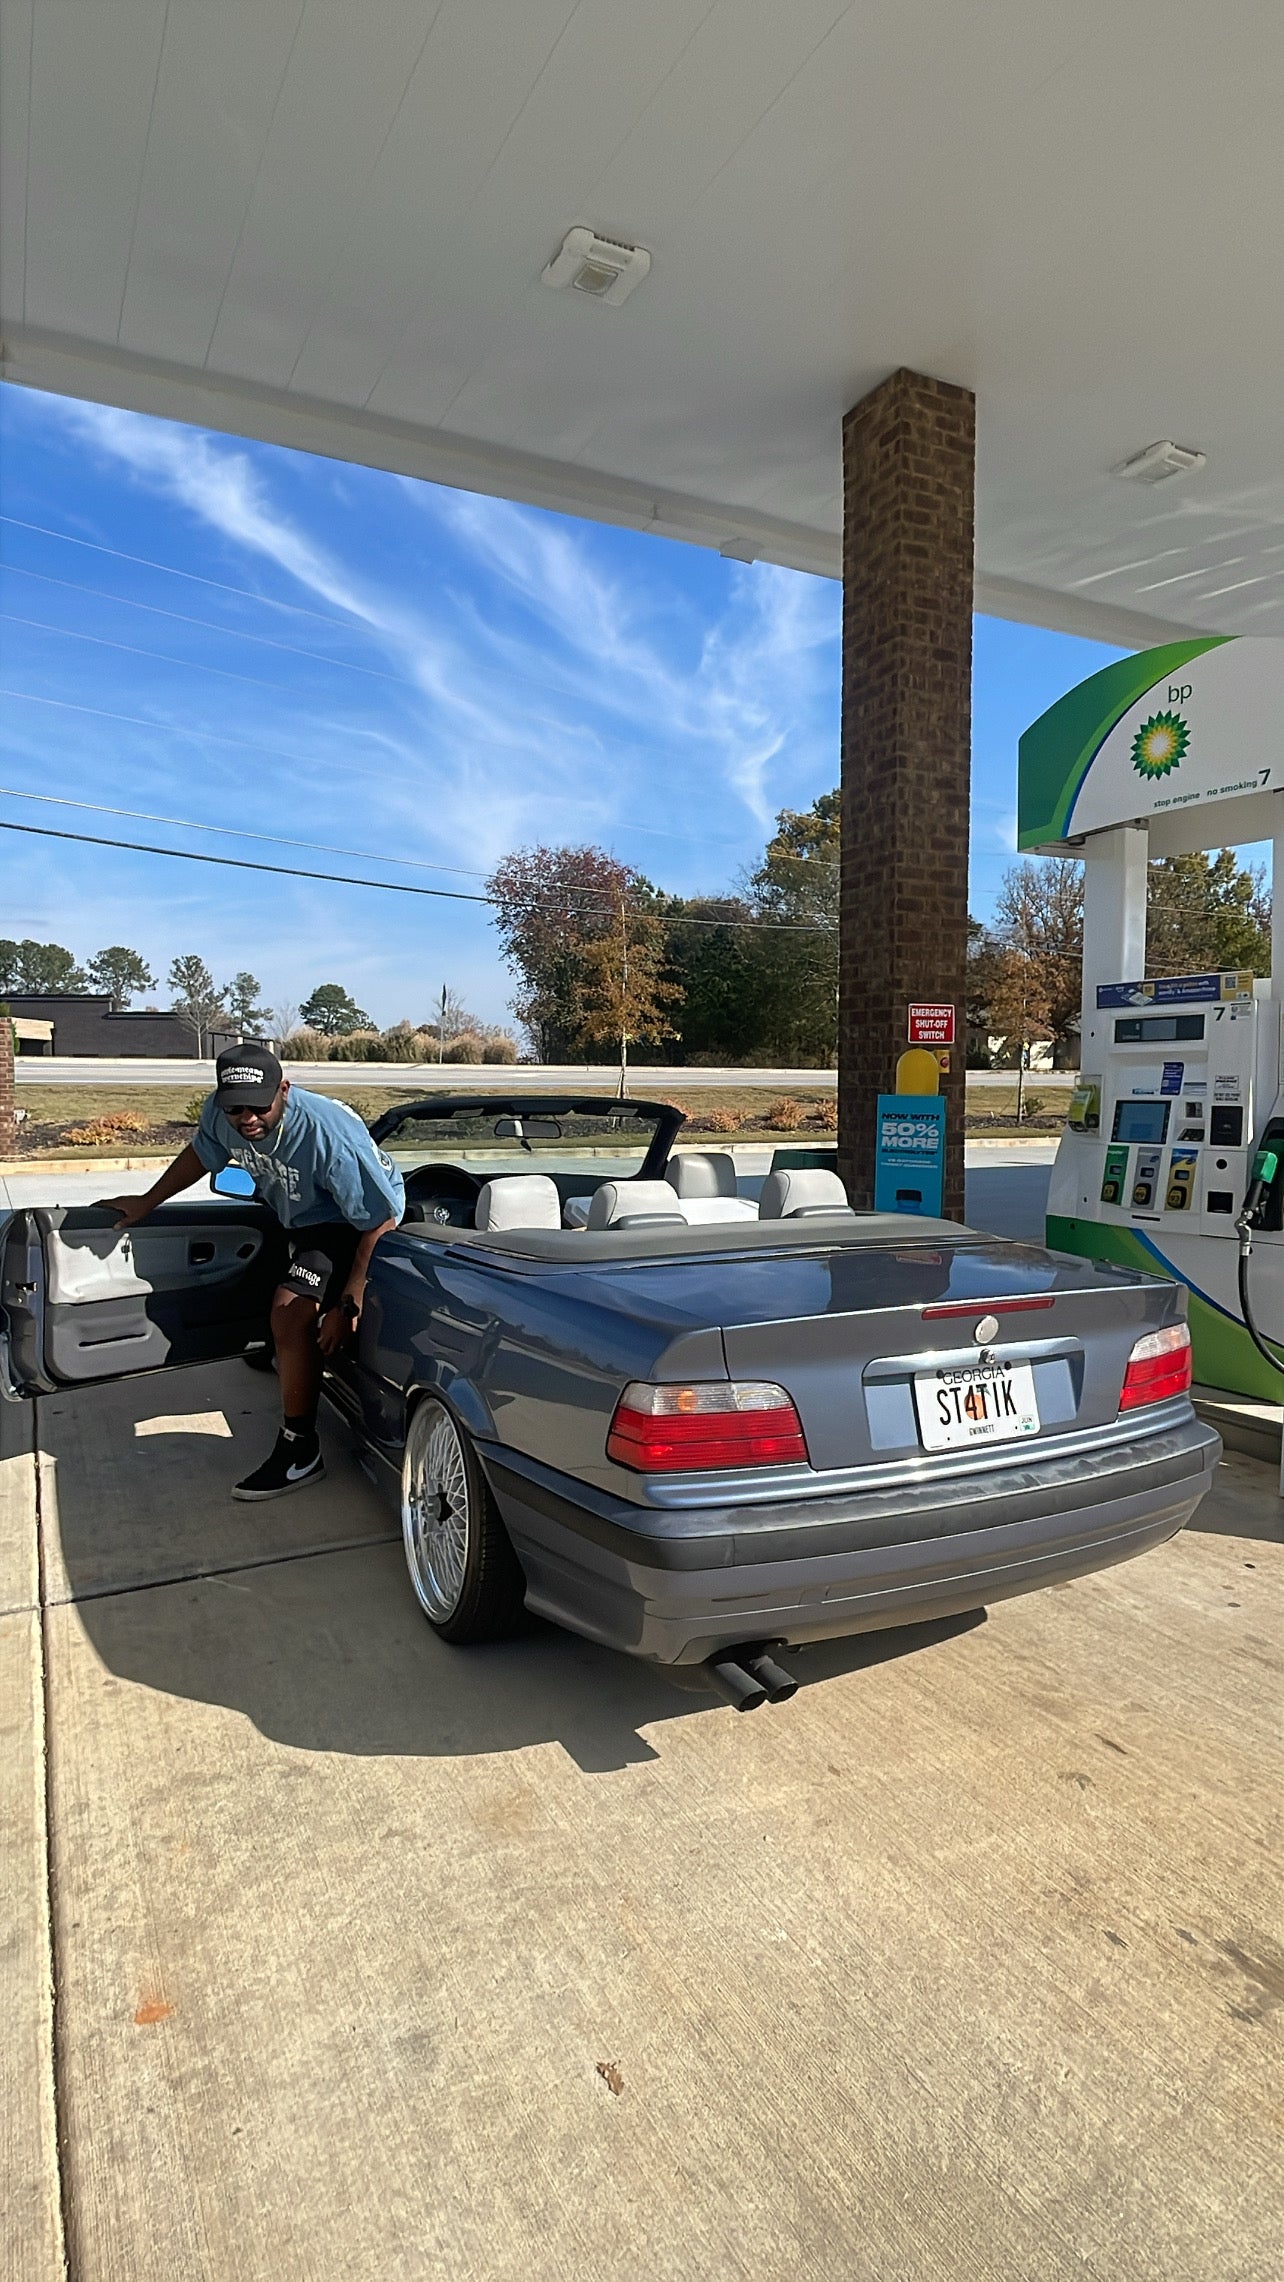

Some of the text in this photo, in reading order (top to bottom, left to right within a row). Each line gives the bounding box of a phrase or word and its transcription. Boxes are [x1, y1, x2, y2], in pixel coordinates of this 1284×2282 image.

[1168, 684, 1192, 704] bp
[1258, 768, 1271, 786] 7
[1153, 780, 1258, 808] stop engine no smoking
[911, 1008, 952, 1018] EMERGENCY
[1213, 1006, 1226, 1021] 7
[915, 1019, 948, 1029] SHUT-OFF
[918, 1030, 945, 1040] SWITCH
[881, 1122, 939, 1137] 50%
[881, 1136, 939, 1149] MORE
[942, 1365, 1005, 1385] GEORGIA
[936, 1380, 1018, 1425] ST4TIK
[969, 1424, 995, 1436] GWINNETT
